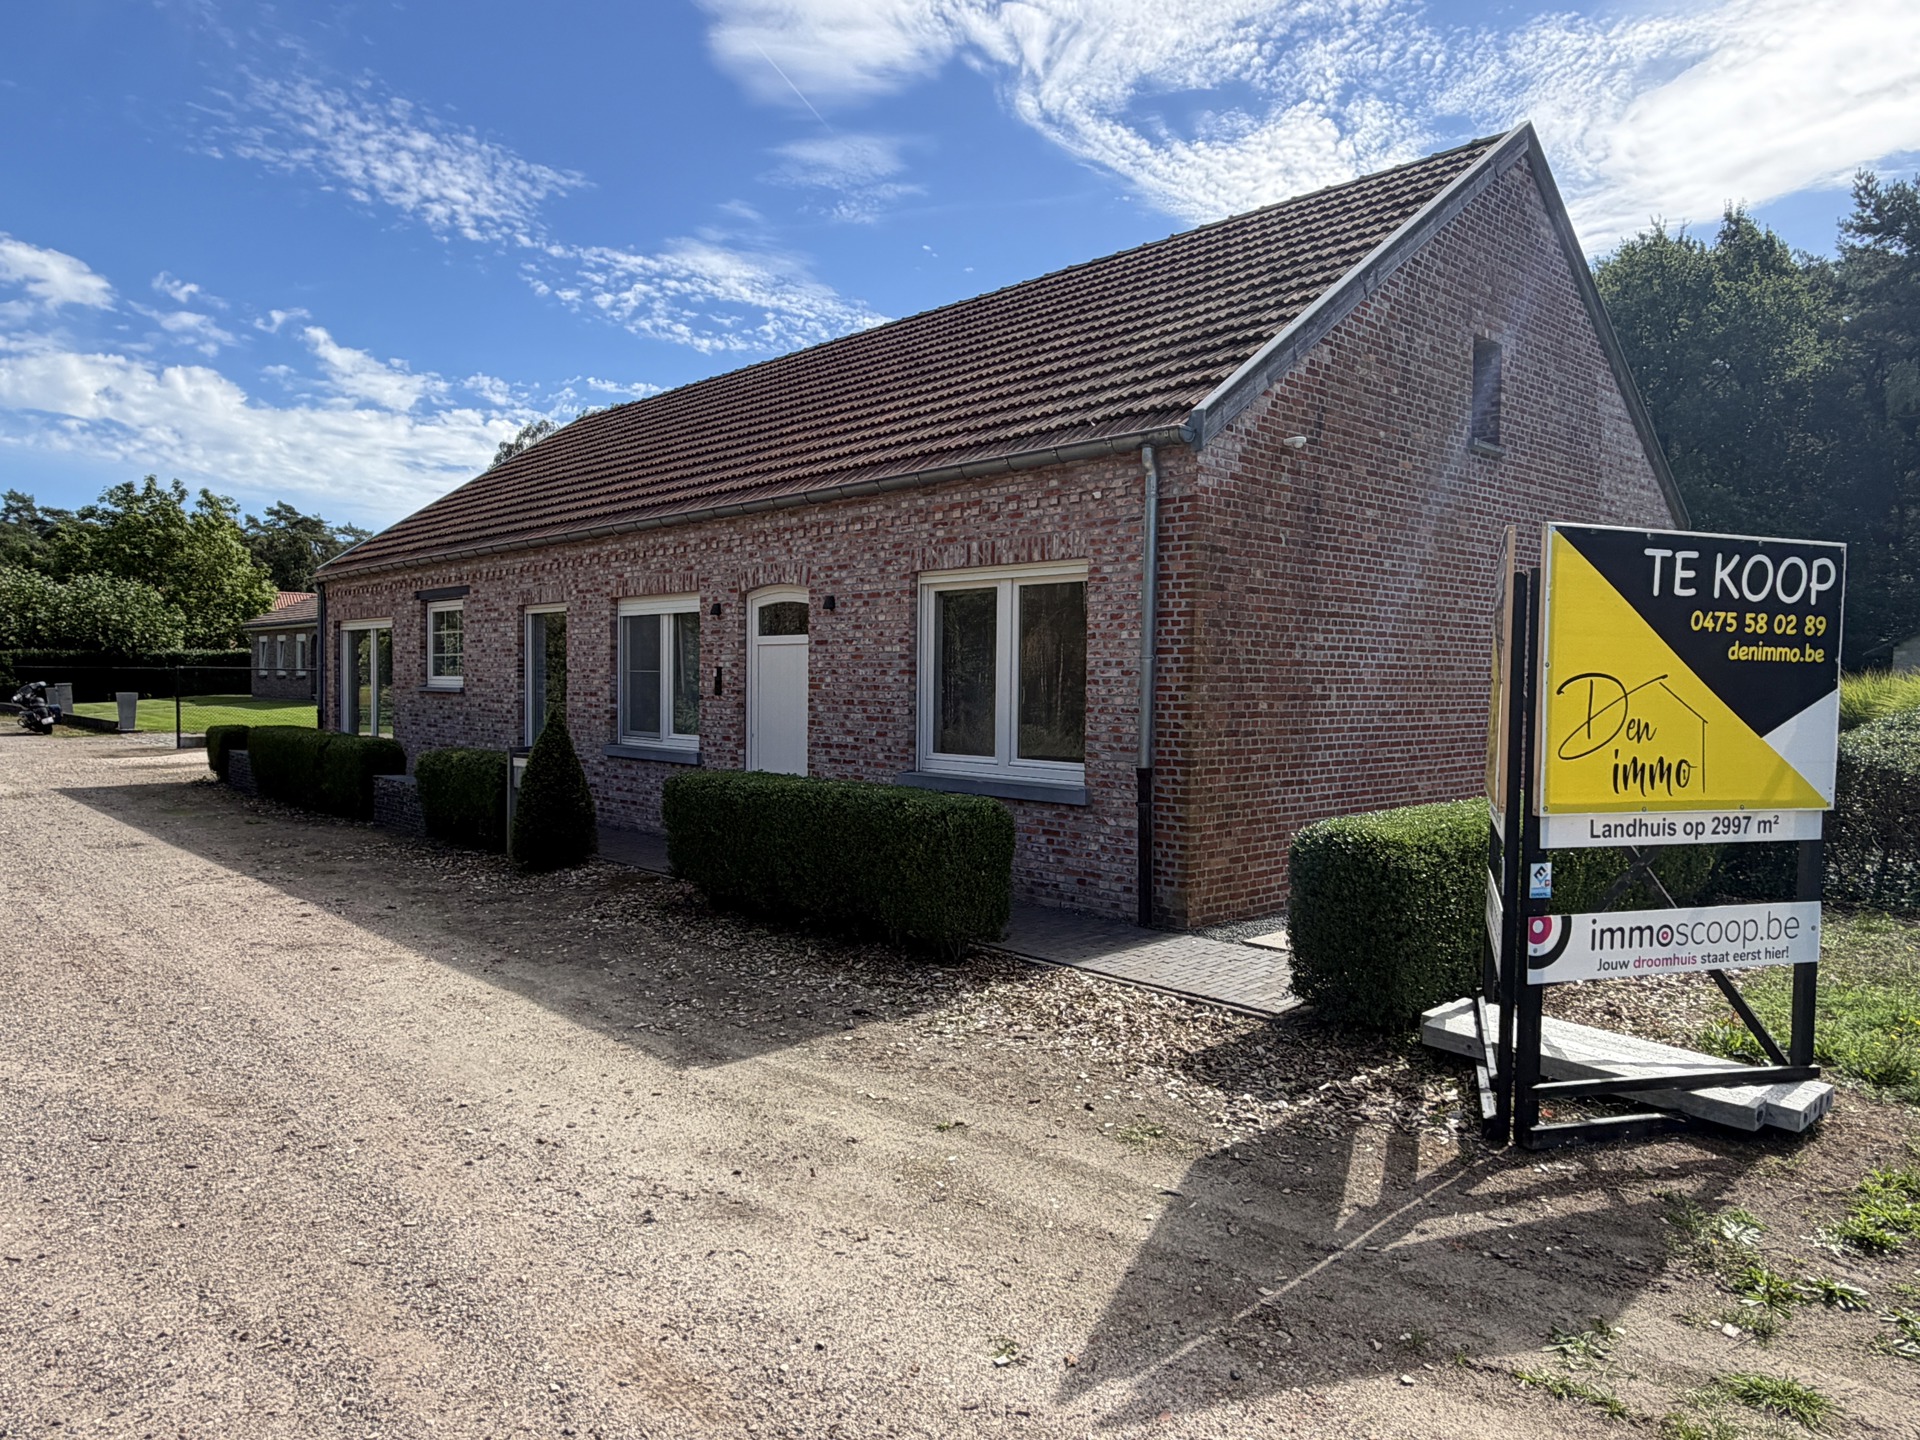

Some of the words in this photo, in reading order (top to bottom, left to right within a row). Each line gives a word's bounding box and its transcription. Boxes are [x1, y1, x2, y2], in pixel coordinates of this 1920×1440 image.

[1644, 548, 1699, 596] TE
[1713, 552, 1836, 606] KOOP
[1690, 610, 1737, 632] 0475
[1744, 613, 1768, 634] 58
[1773, 614, 1797, 635] 02
[1804, 615, 1827, 637] 89
[1727, 640, 1825, 663] denimmo.be
[1556, 672, 1668, 760] Den
[1613, 749, 1697, 797] immo
[1590, 818, 1677, 839] Landhuis
[1683, 821, 1705, 840] op
[1711, 816, 1752, 835] 2997
[1590, 910, 1800, 951] immoscoop.be
[1597, 958, 1630, 972] Jouw
[1633, 952, 1697, 969] droomhuis
[1700, 951, 1730, 964] staat
[1733, 948, 1762, 962] eerst
[1764, 946, 1790, 959] hier!
